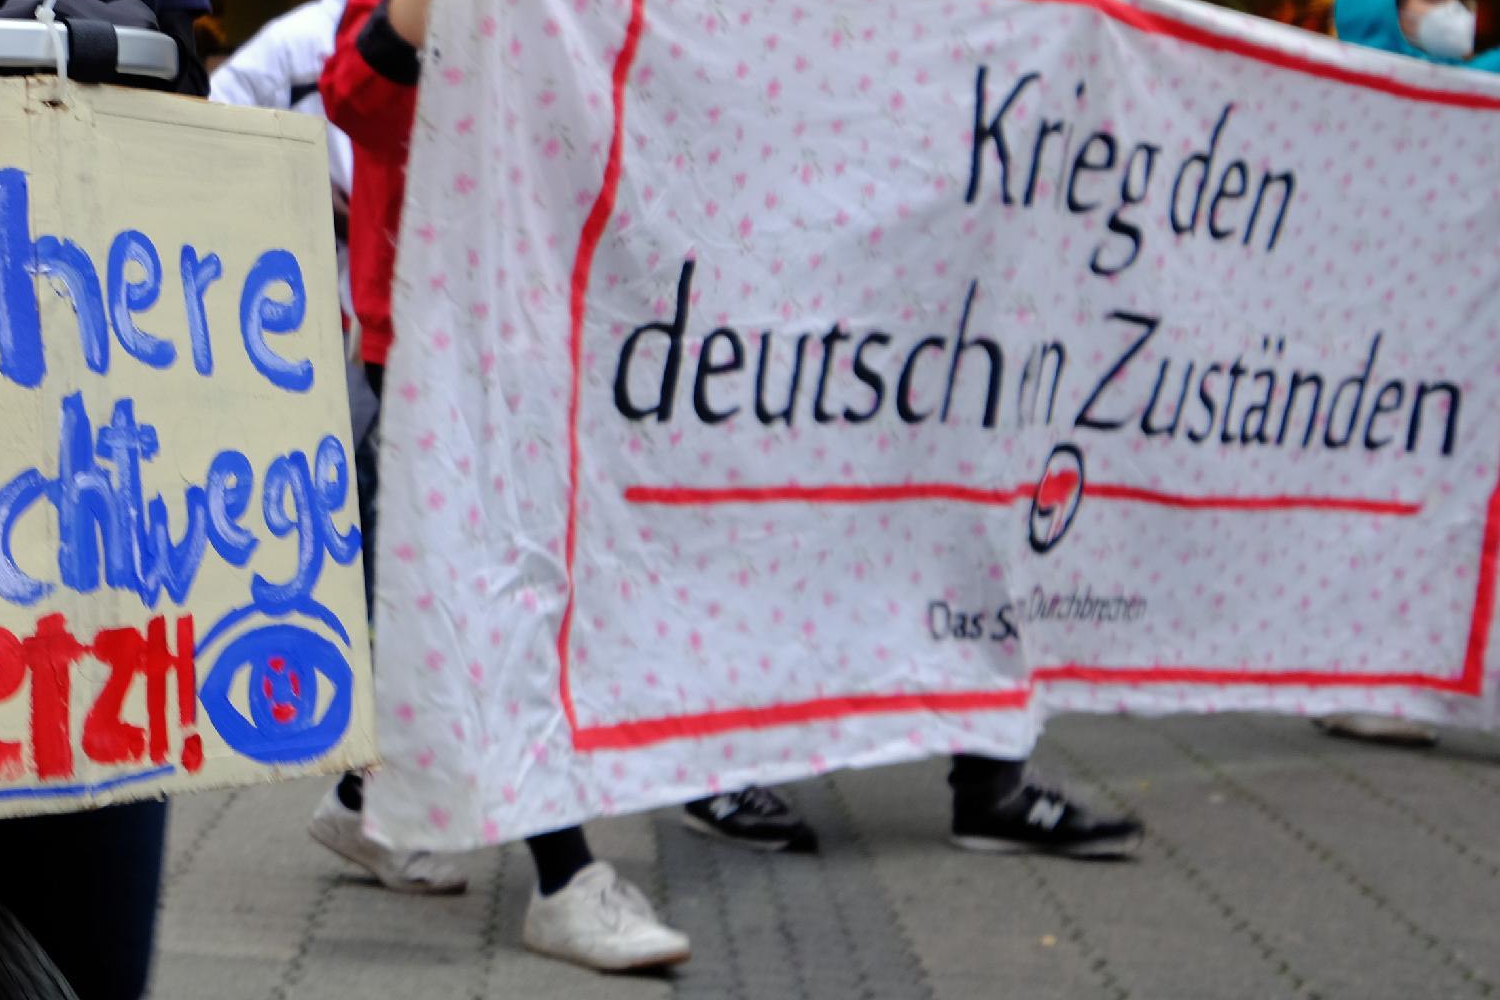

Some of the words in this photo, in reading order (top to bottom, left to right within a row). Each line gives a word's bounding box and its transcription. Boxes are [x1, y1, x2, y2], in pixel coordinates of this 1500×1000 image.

[963, 66, 1163, 277] Krieg
[1168, 104, 1296, 251] den
[610, 259, 1066, 430] deutschn
[1073, 310, 1464, 458] Zuständen
[927, 600, 984, 640] Das
